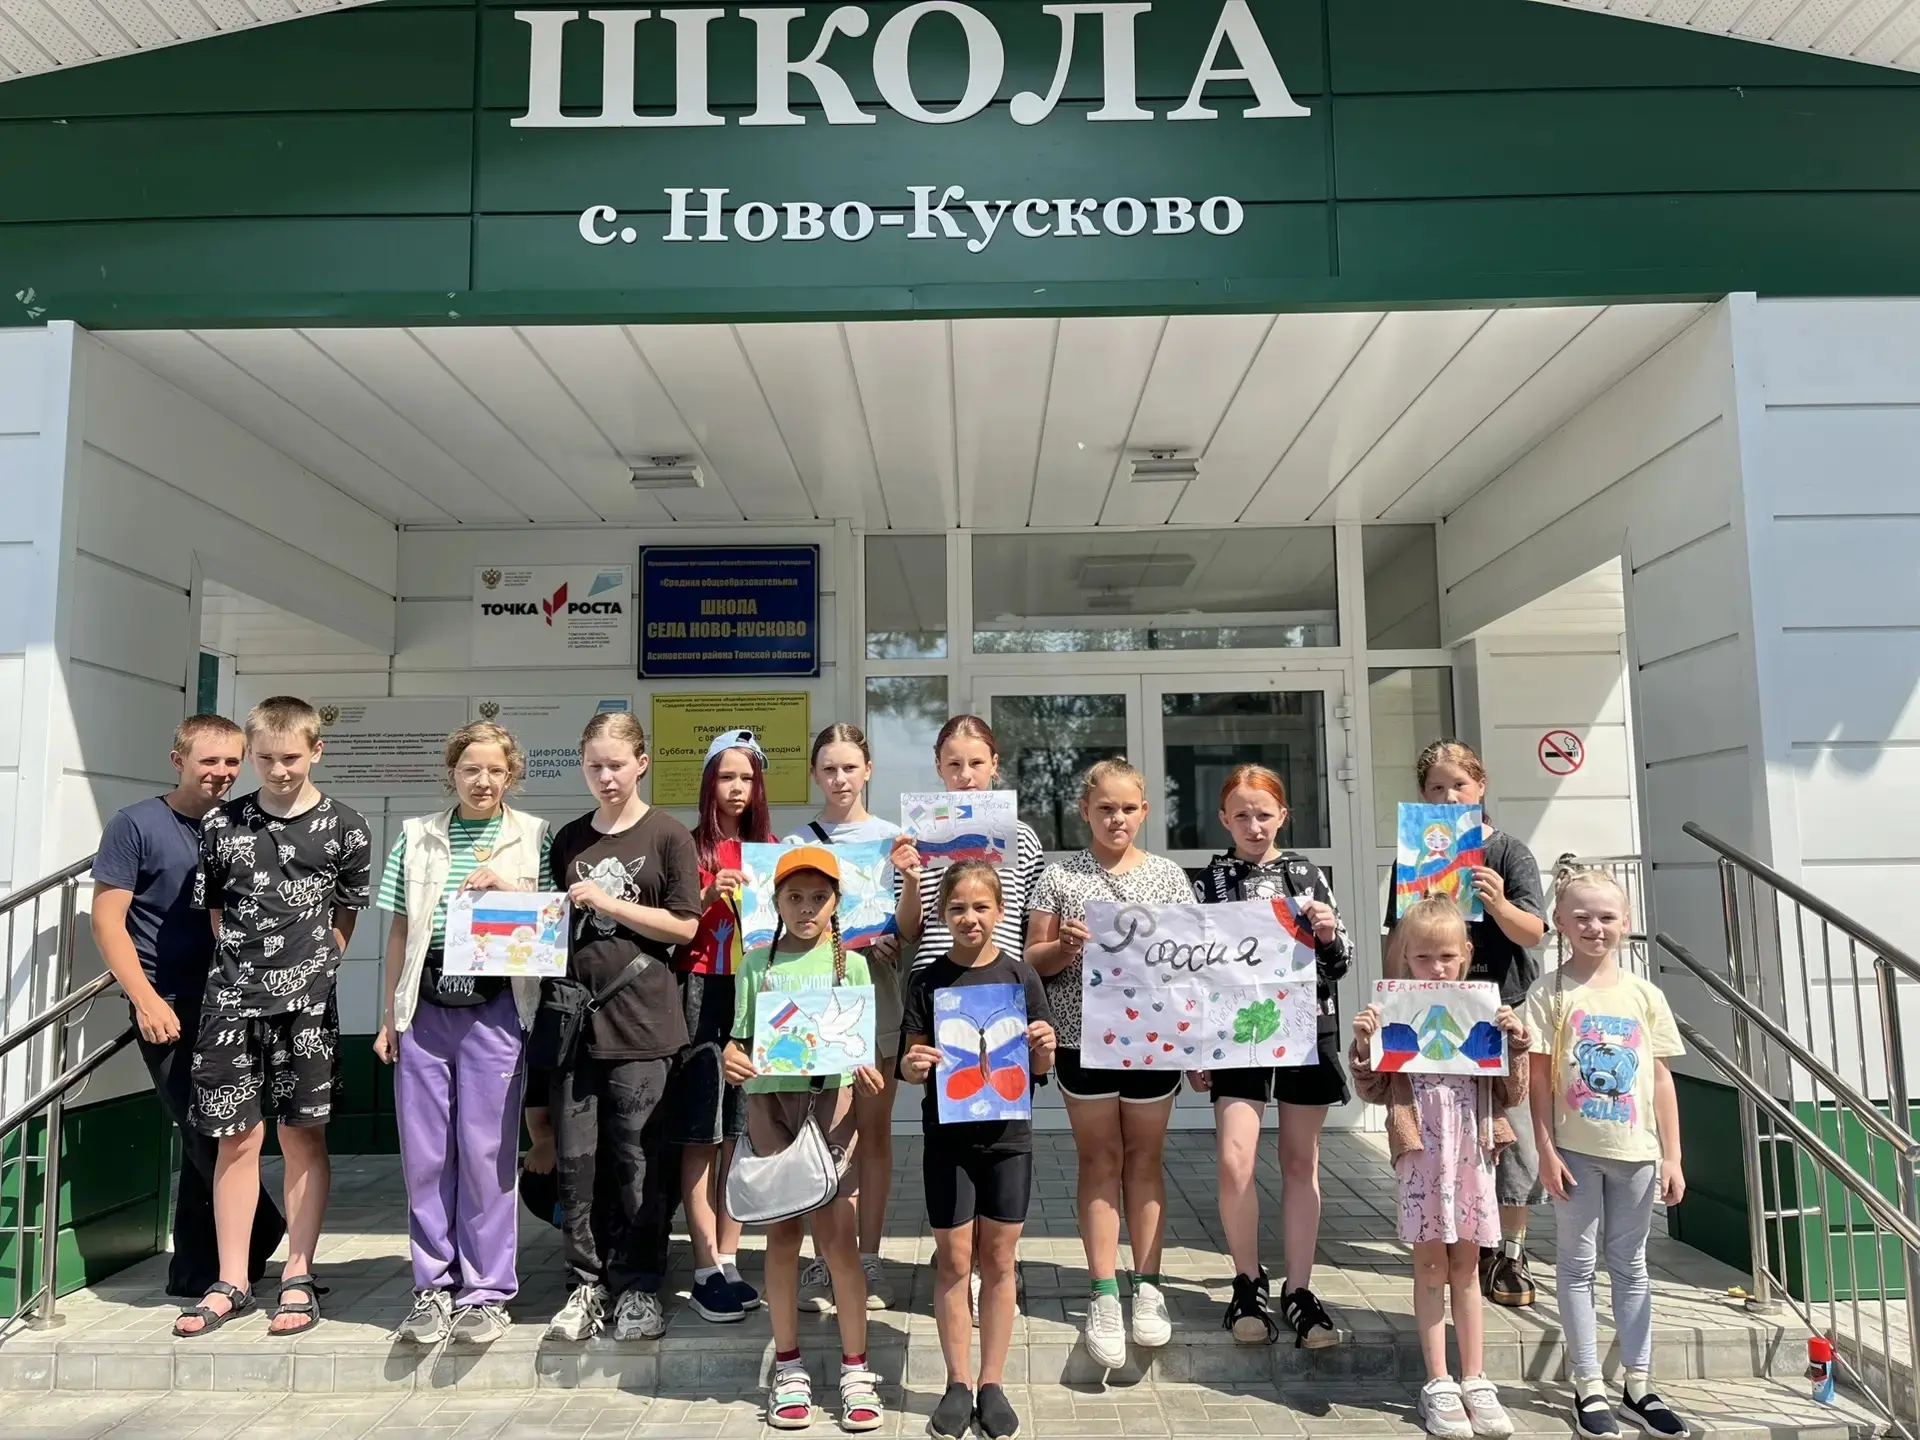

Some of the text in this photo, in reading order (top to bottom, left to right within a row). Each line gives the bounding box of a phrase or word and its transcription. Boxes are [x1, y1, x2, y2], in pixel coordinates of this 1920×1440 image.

[510, 0, 1311, 126] ШКОЛА
[578, 185, 1244, 254] с. Ново-Кусково
[481, 602, 623, 616] ТОЧКА РОСТА
[700, 598, 758, 615] ШКОЛА
[647, 620, 807, 638] СЕЛА НОВО-КУСКОВО
[647, 651, 701, 661] Асиновского
[702, 650, 733, 660] района
[734, 650, 771, 659] Томской
[693, 725, 726, 733] ГРАФИК
[659, 748, 696, 756] Суббота,
[528, 769, 562, 779] СРЕДА
[1100, 904, 1263, 972] Россия
[1580, 1014, 1639, 1037] STREET
